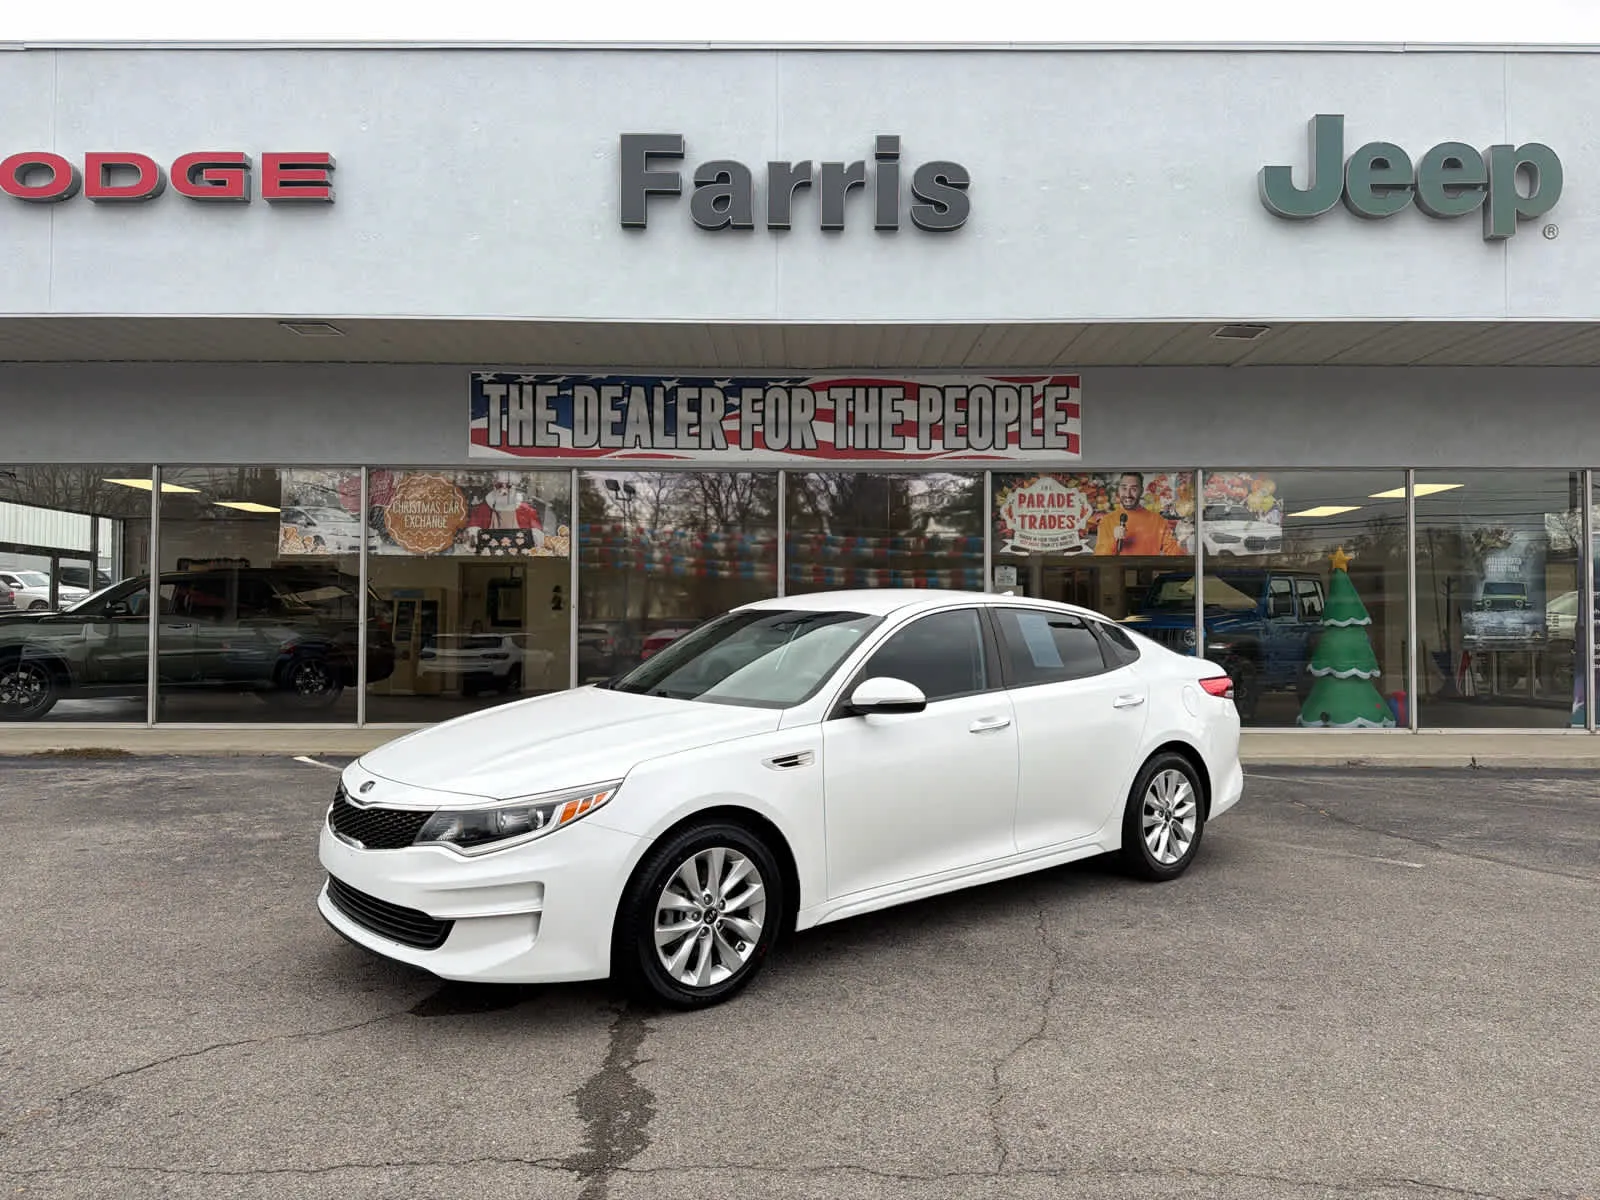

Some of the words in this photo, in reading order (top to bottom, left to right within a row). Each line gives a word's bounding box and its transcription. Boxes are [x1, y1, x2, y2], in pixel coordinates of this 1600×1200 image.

[0, 151, 335, 204] ODGE
[619, 133, 970, 231] Farris
[1258, 114, 1563, 240] Jeep
[483, 383, 560, 448] THE
[572, 384, 728, 449] DEALER
[740, 386, 817, 450] FOR
[828, 385, 905, 450] THE
[917, 385, 1069, 450] PEOPLE
[393, 501, 440, 514] CHRISTMAS
[443, 500, 460, 514] CAR
[1018, 492, 1075, 508] PARADE
[404, 515, 448, 528] EXCHANGE
[1018, 514, 1076, 530] TRADES
